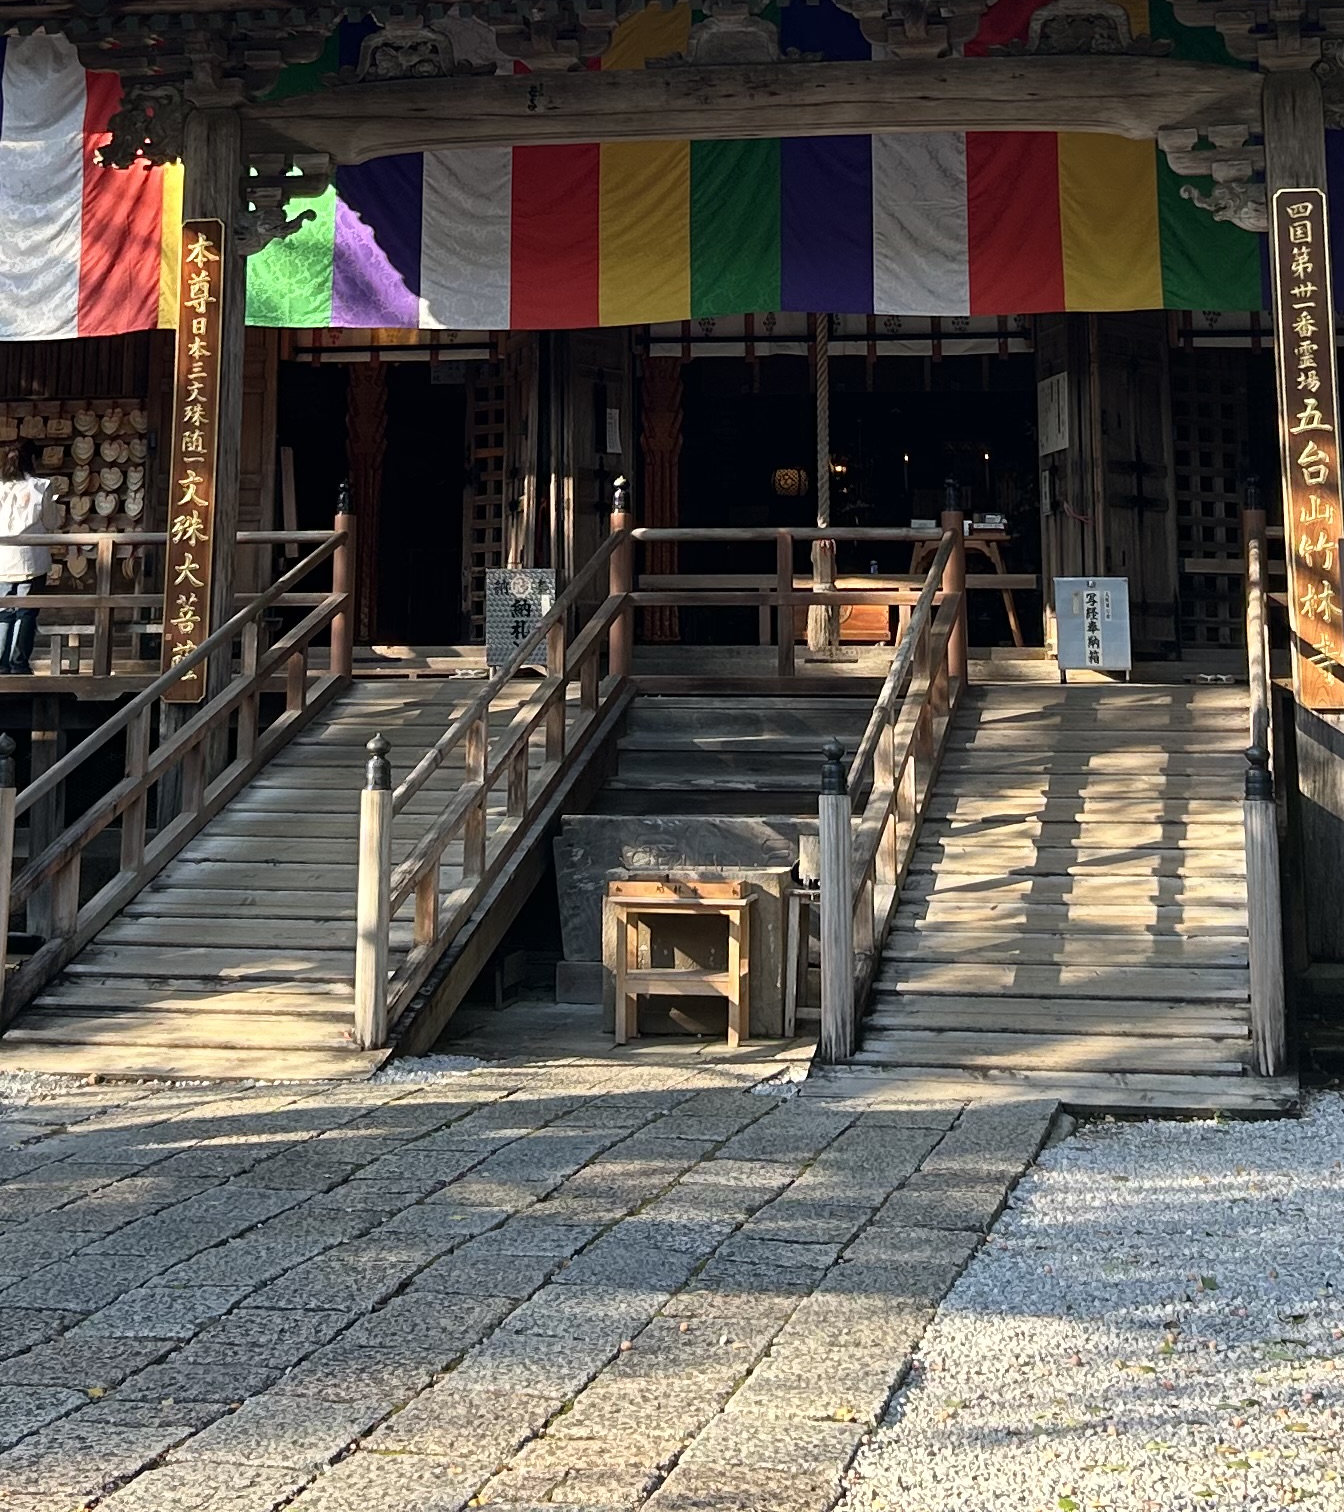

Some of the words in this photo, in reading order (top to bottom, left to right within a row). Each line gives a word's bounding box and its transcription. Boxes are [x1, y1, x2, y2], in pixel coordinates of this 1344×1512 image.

[1085, 592, 1100, 665] 写経奉納箱
